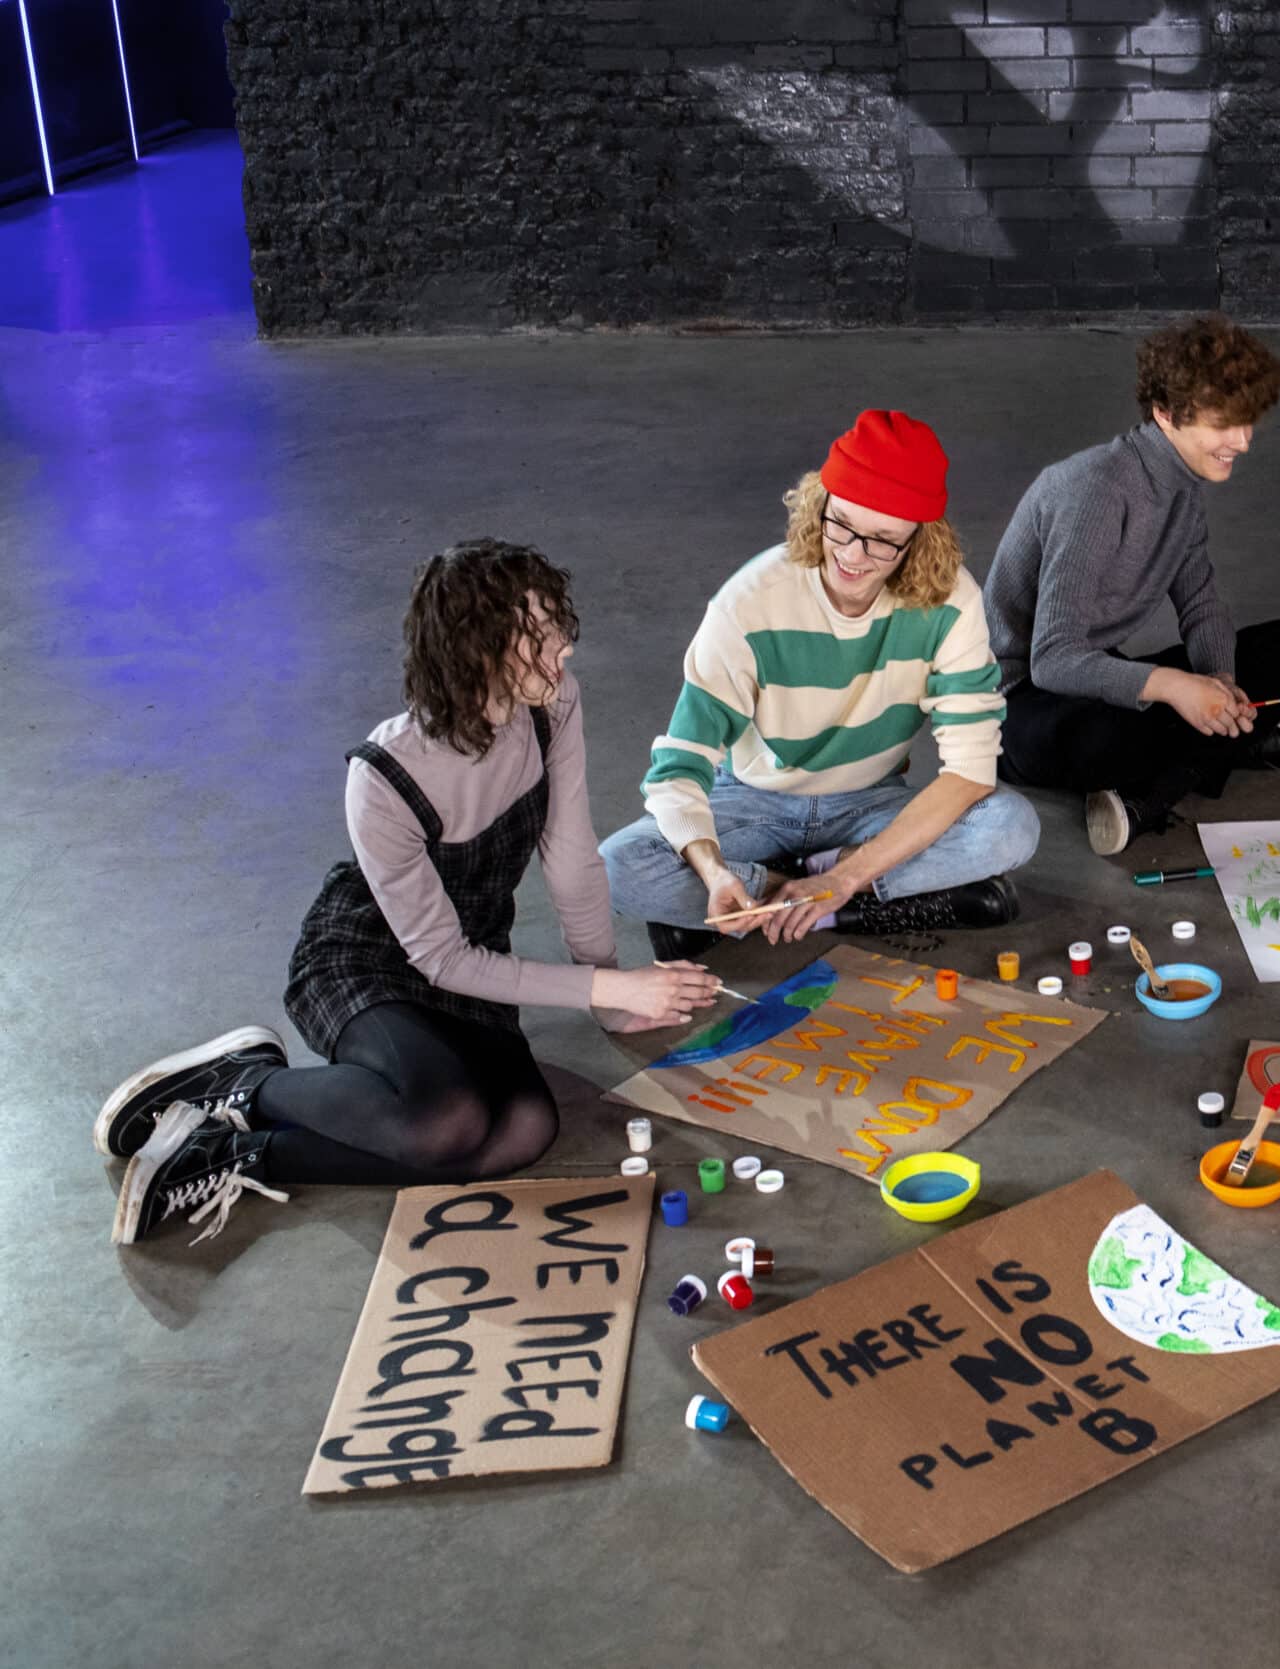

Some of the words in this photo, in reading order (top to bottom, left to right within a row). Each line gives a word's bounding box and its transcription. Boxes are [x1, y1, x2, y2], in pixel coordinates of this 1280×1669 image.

[815, 1009, 948, 1097] HAVE
[944, 1011, 1074, 1074] WE
[536, 1189, 630, 1290] WE
[764, 1303, 967, 1399] THERE
[975, 1259, 1052, 1314] IS
[950, 1313, 1094, 1404] NO
[899, 1355, 1153, 1491] PLANET
